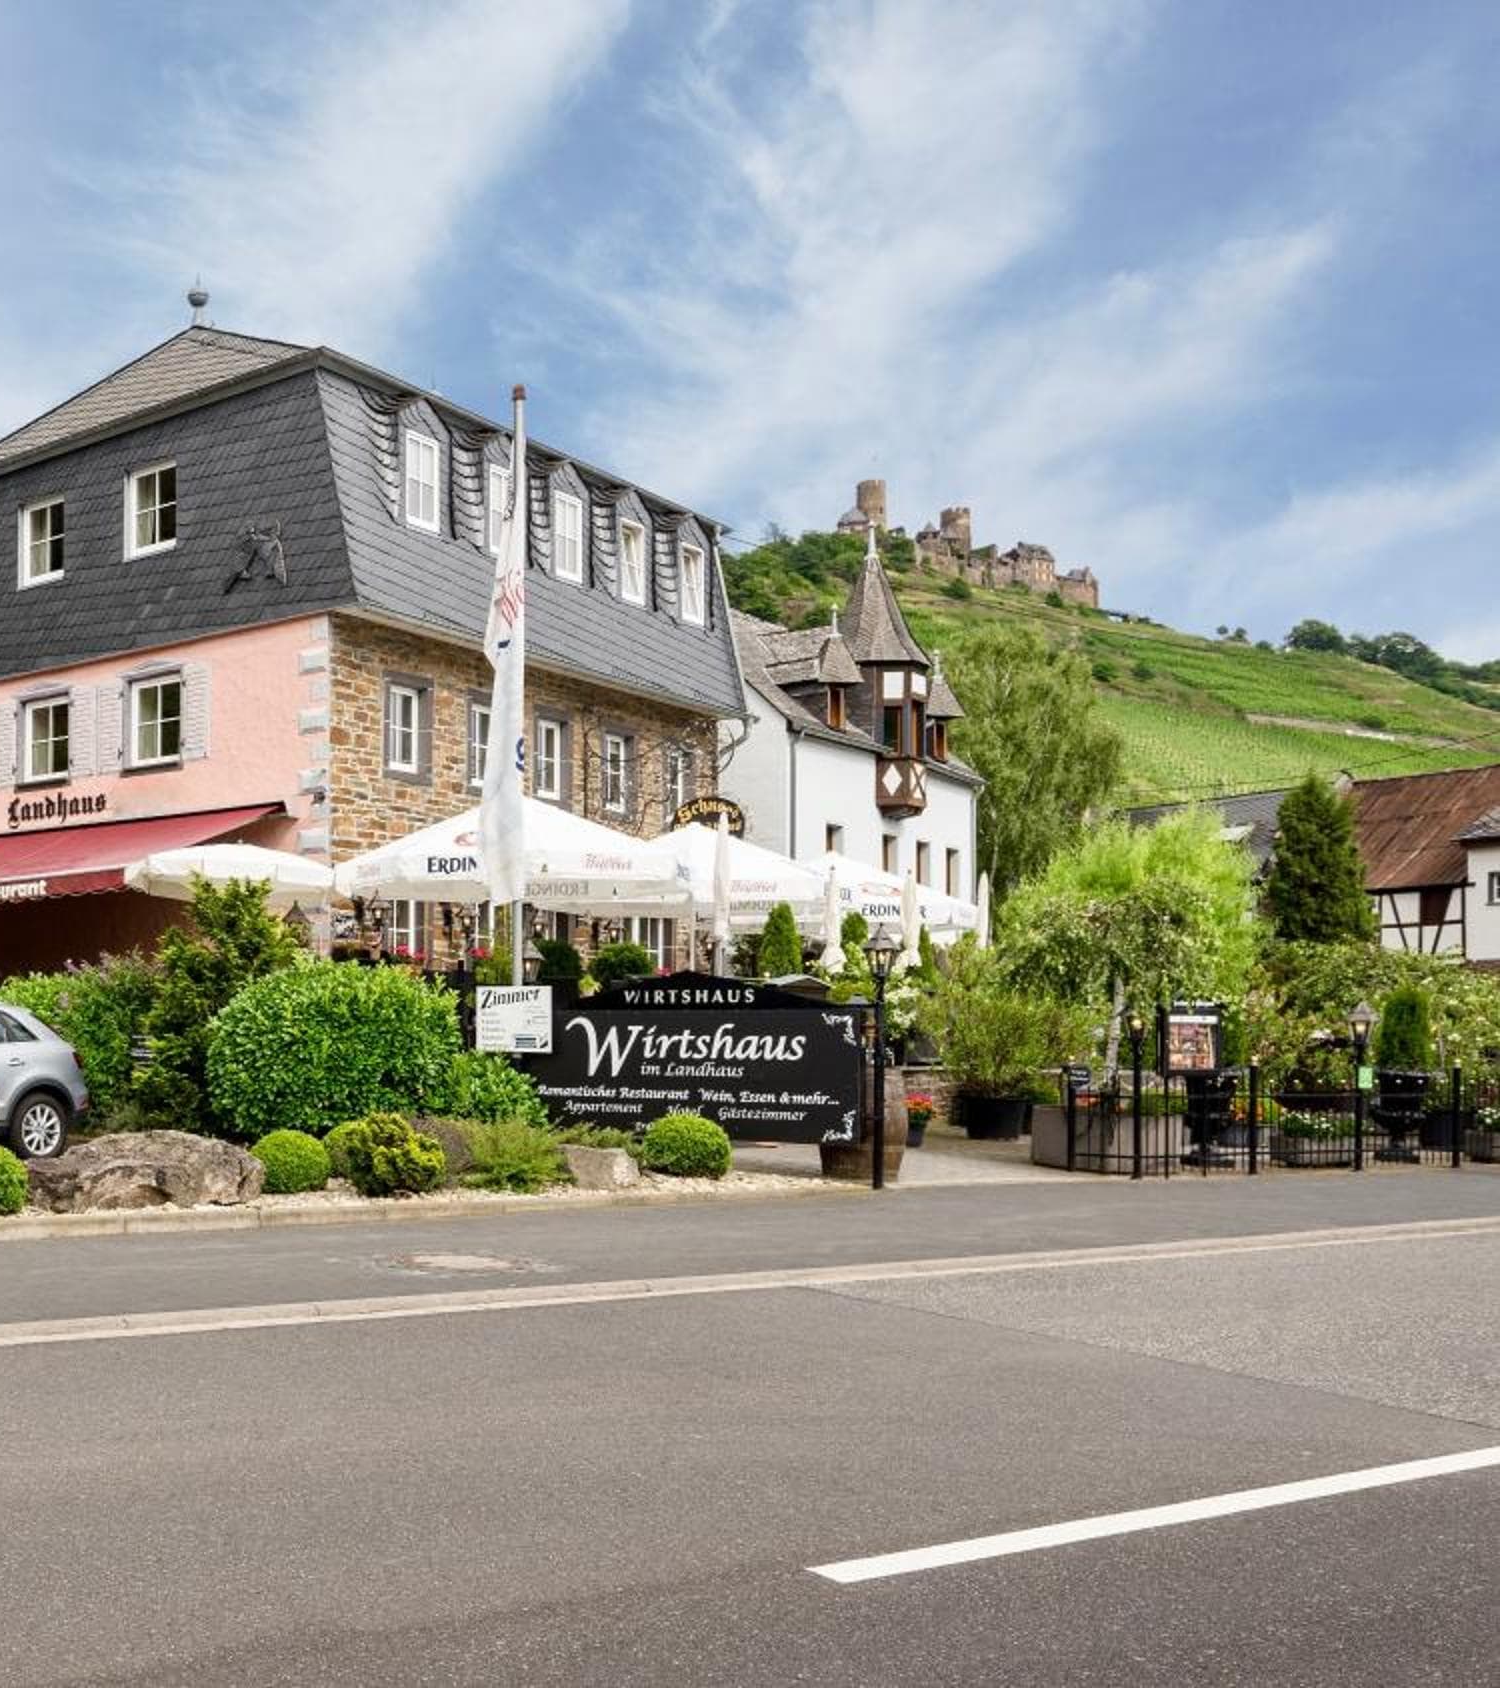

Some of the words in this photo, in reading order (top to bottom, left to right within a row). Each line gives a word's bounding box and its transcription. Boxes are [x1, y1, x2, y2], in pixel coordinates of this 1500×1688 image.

[8, 792, 106, 828] Landhaus
[427, 856, 478, 874] ERDIN
[861, 903, 928, 919] ERDINR
[481, 988, 540, 1009] Zimmer
[624, 988, 755, 1004] WIRTSHAUS
[565, 1016, 807, 1078] Wirtshaus
[640, 1061, 661, 1076] im
[664, 1062, 744, 1078] Landhaus
[619, 1086, 690, 1101] Restaurant
[697, 1087, 736, 1103] Wein,
[739, 1090, 776, 1103] Essen
[563, 1099, 643, 1115] Appartement
[717, 1105, 808, 1121] Gästezimmer
